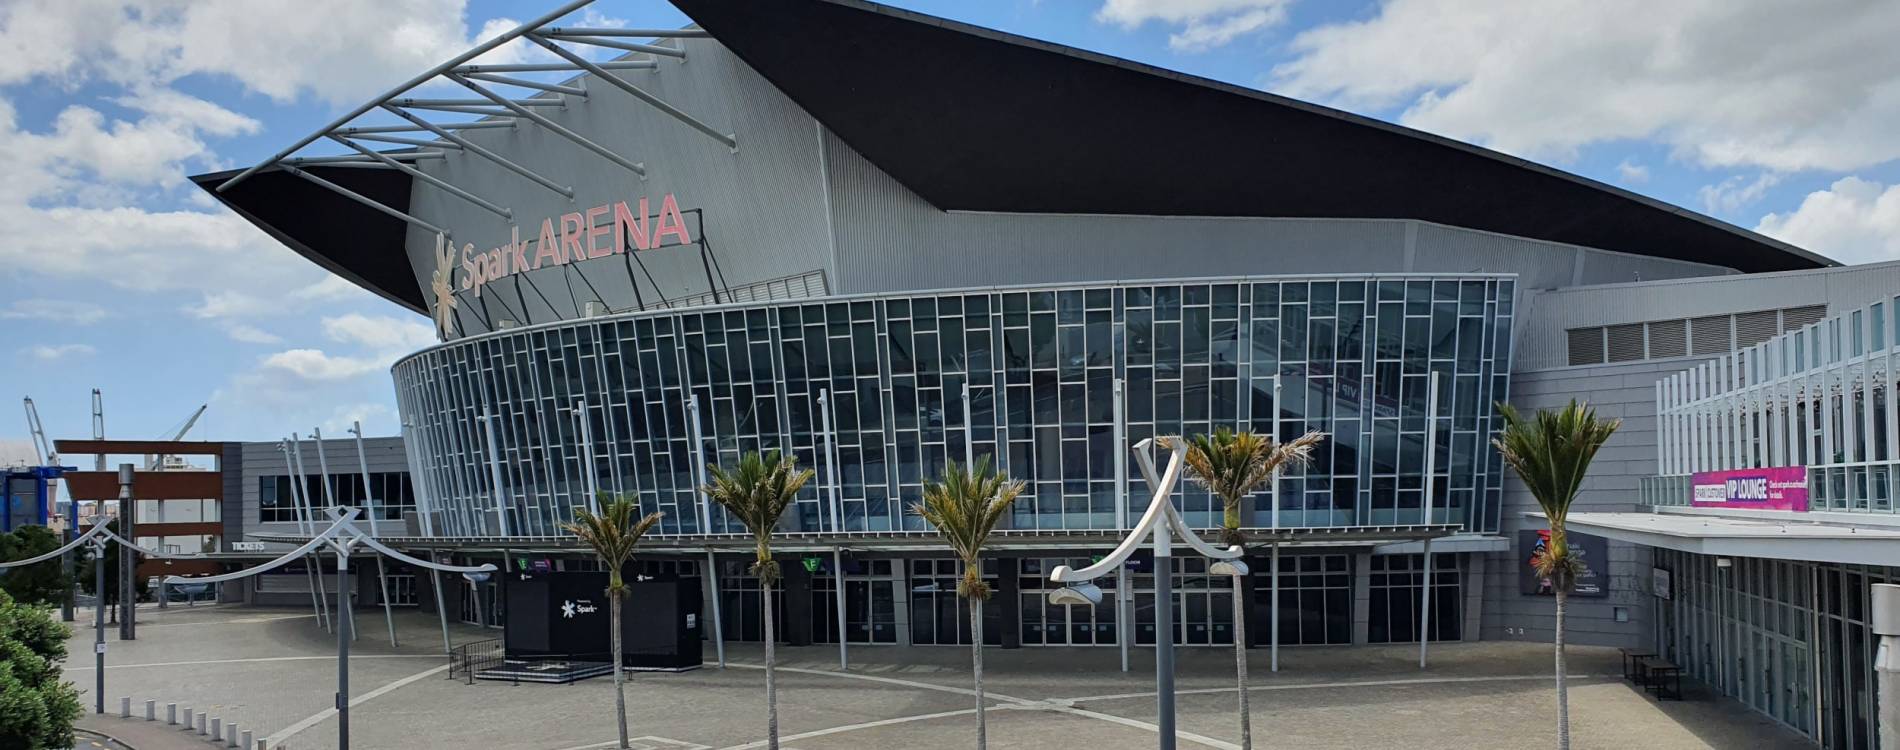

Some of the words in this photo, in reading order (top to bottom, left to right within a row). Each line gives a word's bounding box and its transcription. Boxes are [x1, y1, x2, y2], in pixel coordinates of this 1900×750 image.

[462, 226, 530, 298] Spark
[532, 192, 692, 270] ARENA
[1726, 479, 1737, 499] VIP
[1737, 477, 1767, 499] LOUNGE
[231, 541, 265, 551] TICKETS
